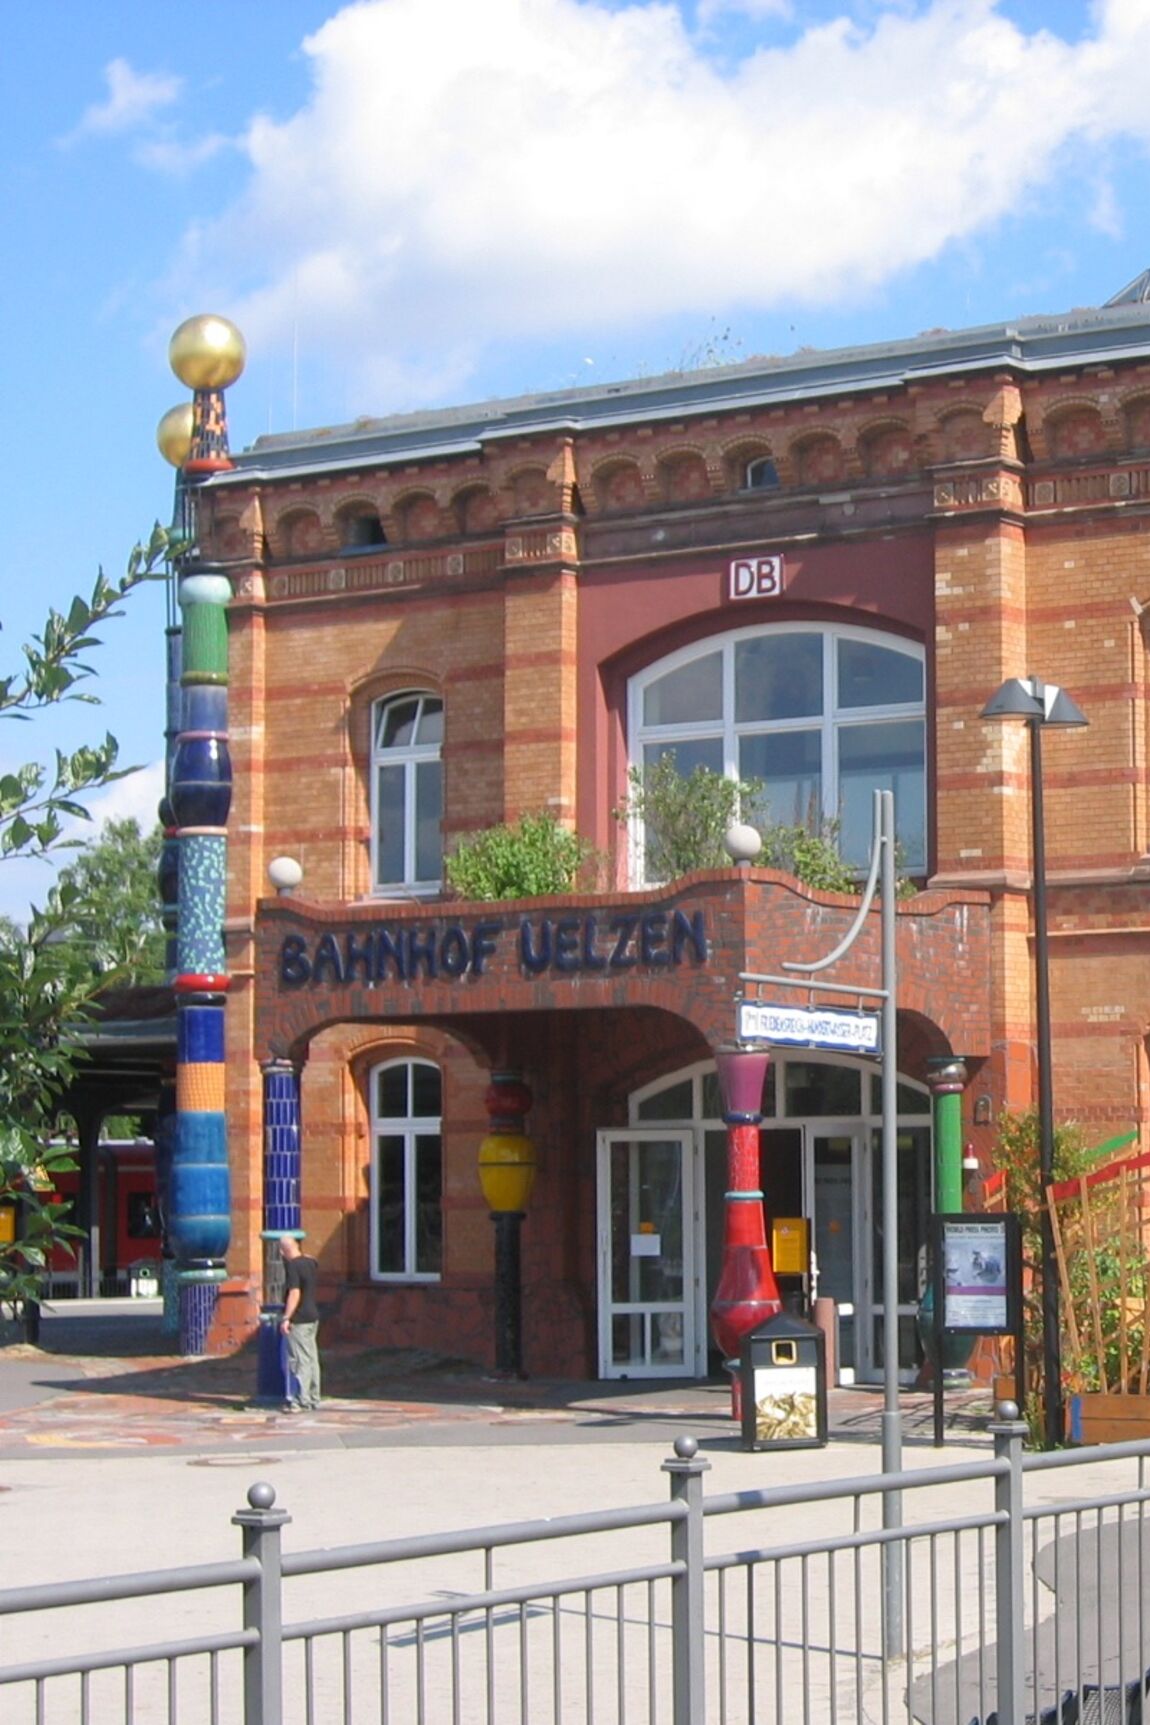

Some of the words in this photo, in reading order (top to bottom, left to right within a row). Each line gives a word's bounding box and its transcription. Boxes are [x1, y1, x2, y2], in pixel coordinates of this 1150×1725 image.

[734, 559, 777, 596] DB
[282, 920, 502, 985] BAHNHOF
[520, 909, 708, 974] UELZEN
